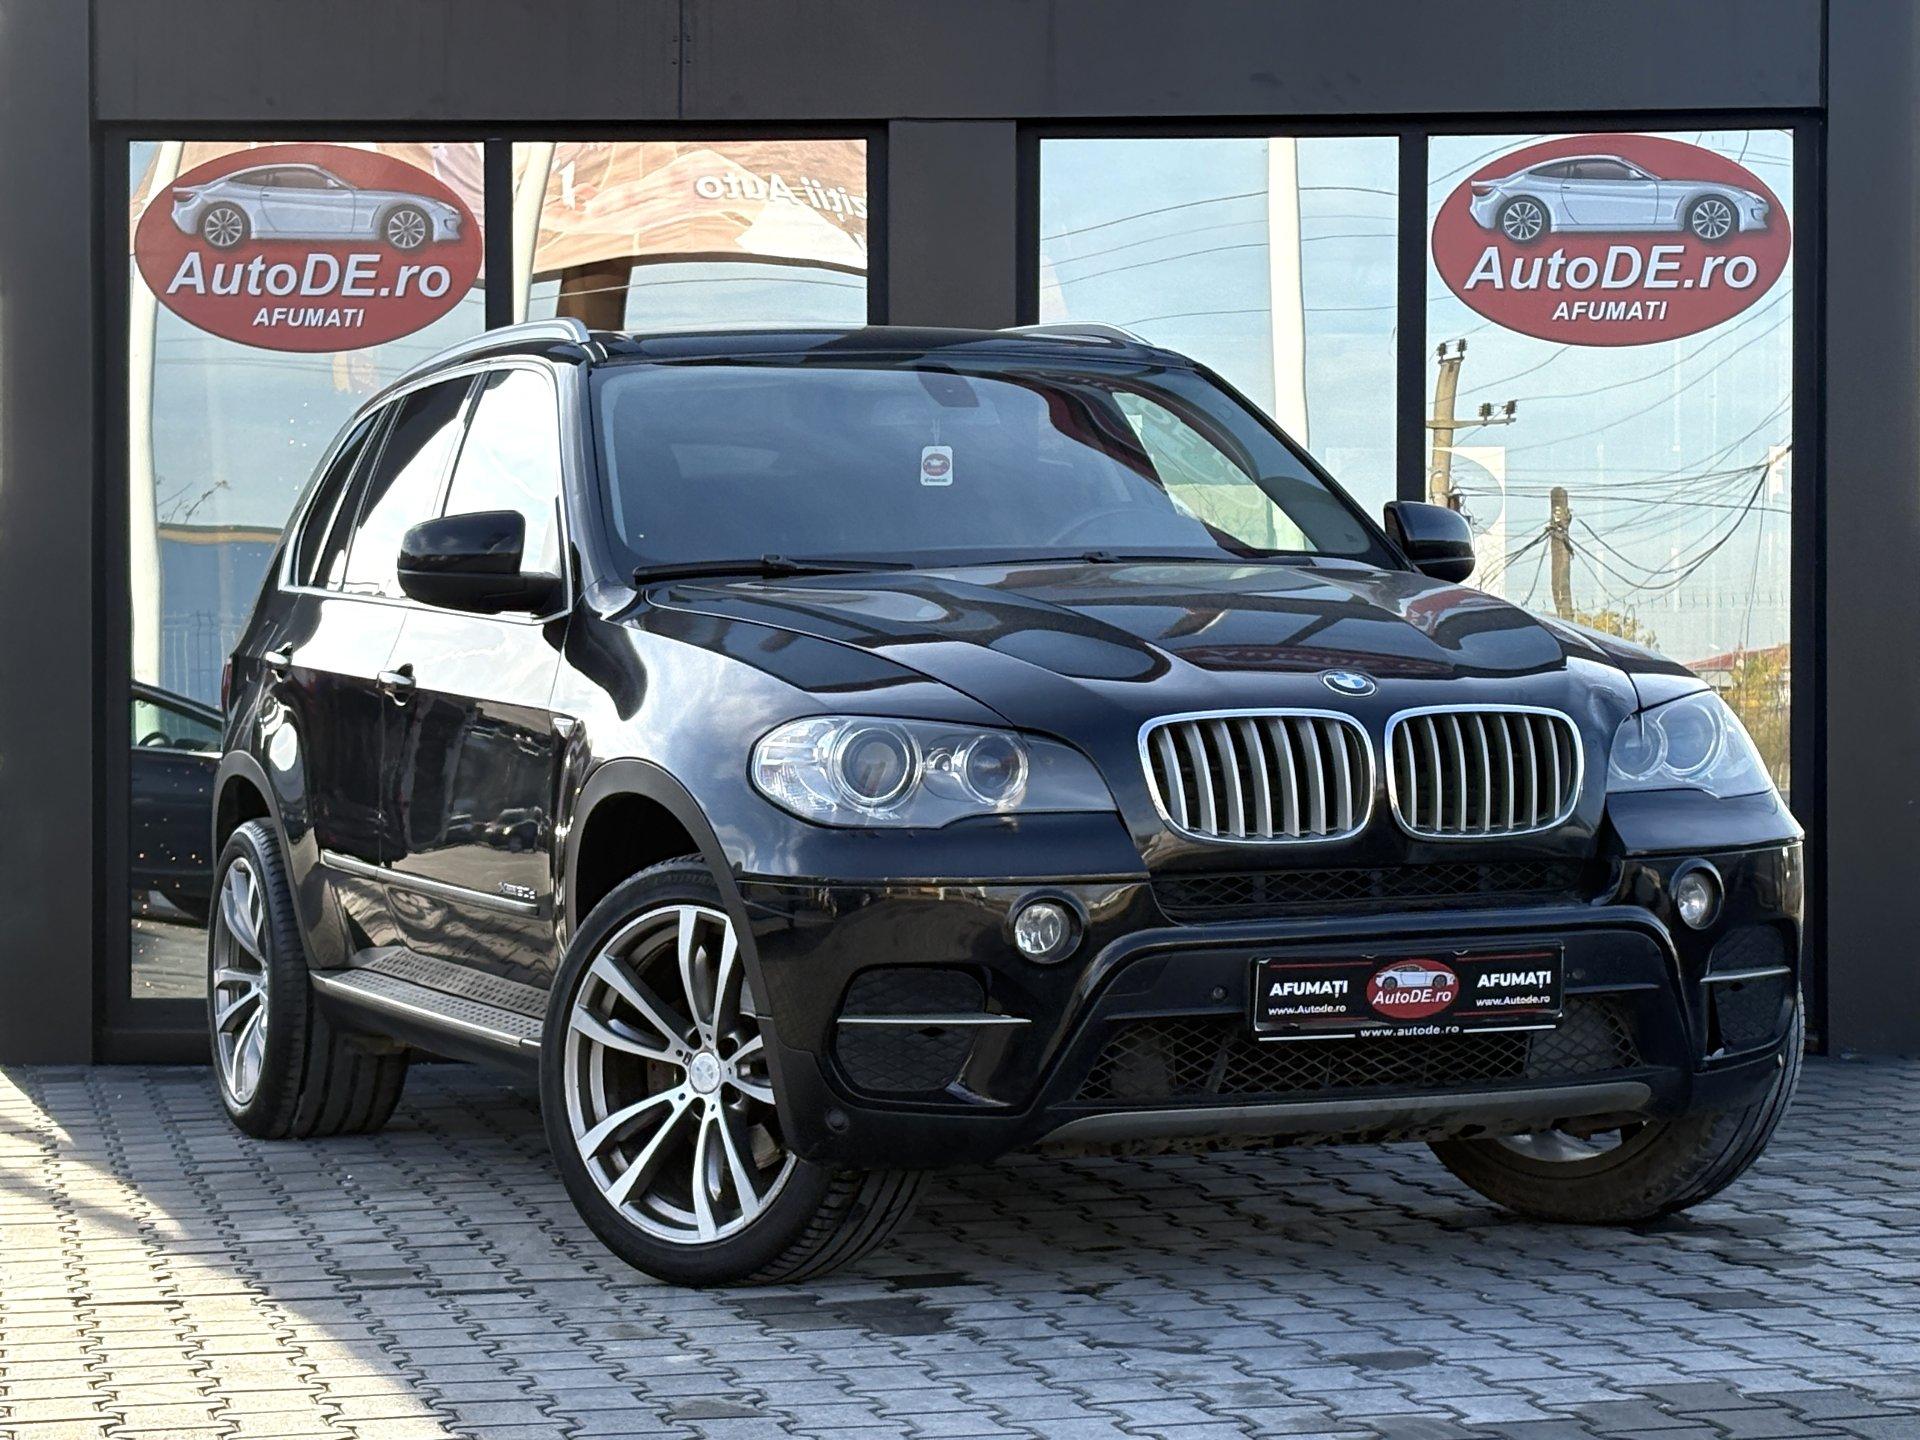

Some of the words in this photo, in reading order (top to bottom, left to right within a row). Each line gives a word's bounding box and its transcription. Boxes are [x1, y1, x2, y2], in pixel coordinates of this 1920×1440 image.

[166, 251, 451, 298] AutoDE.ro
[1463, 245, 1758, 290] AutoDE.ro
[252, 307, 366, 328] AFUMATI
[1552, 301, 1668, 321] AFUMATI
[1372, 989, 1452, 1005] AutoDE.ro
[1475, 995, 1551, 1007] www.Autode.ro
[1268, 1004, 1347, 1015] www.Autode.ro
[1360, 1025, 1460, 1037] www.autode.ro
